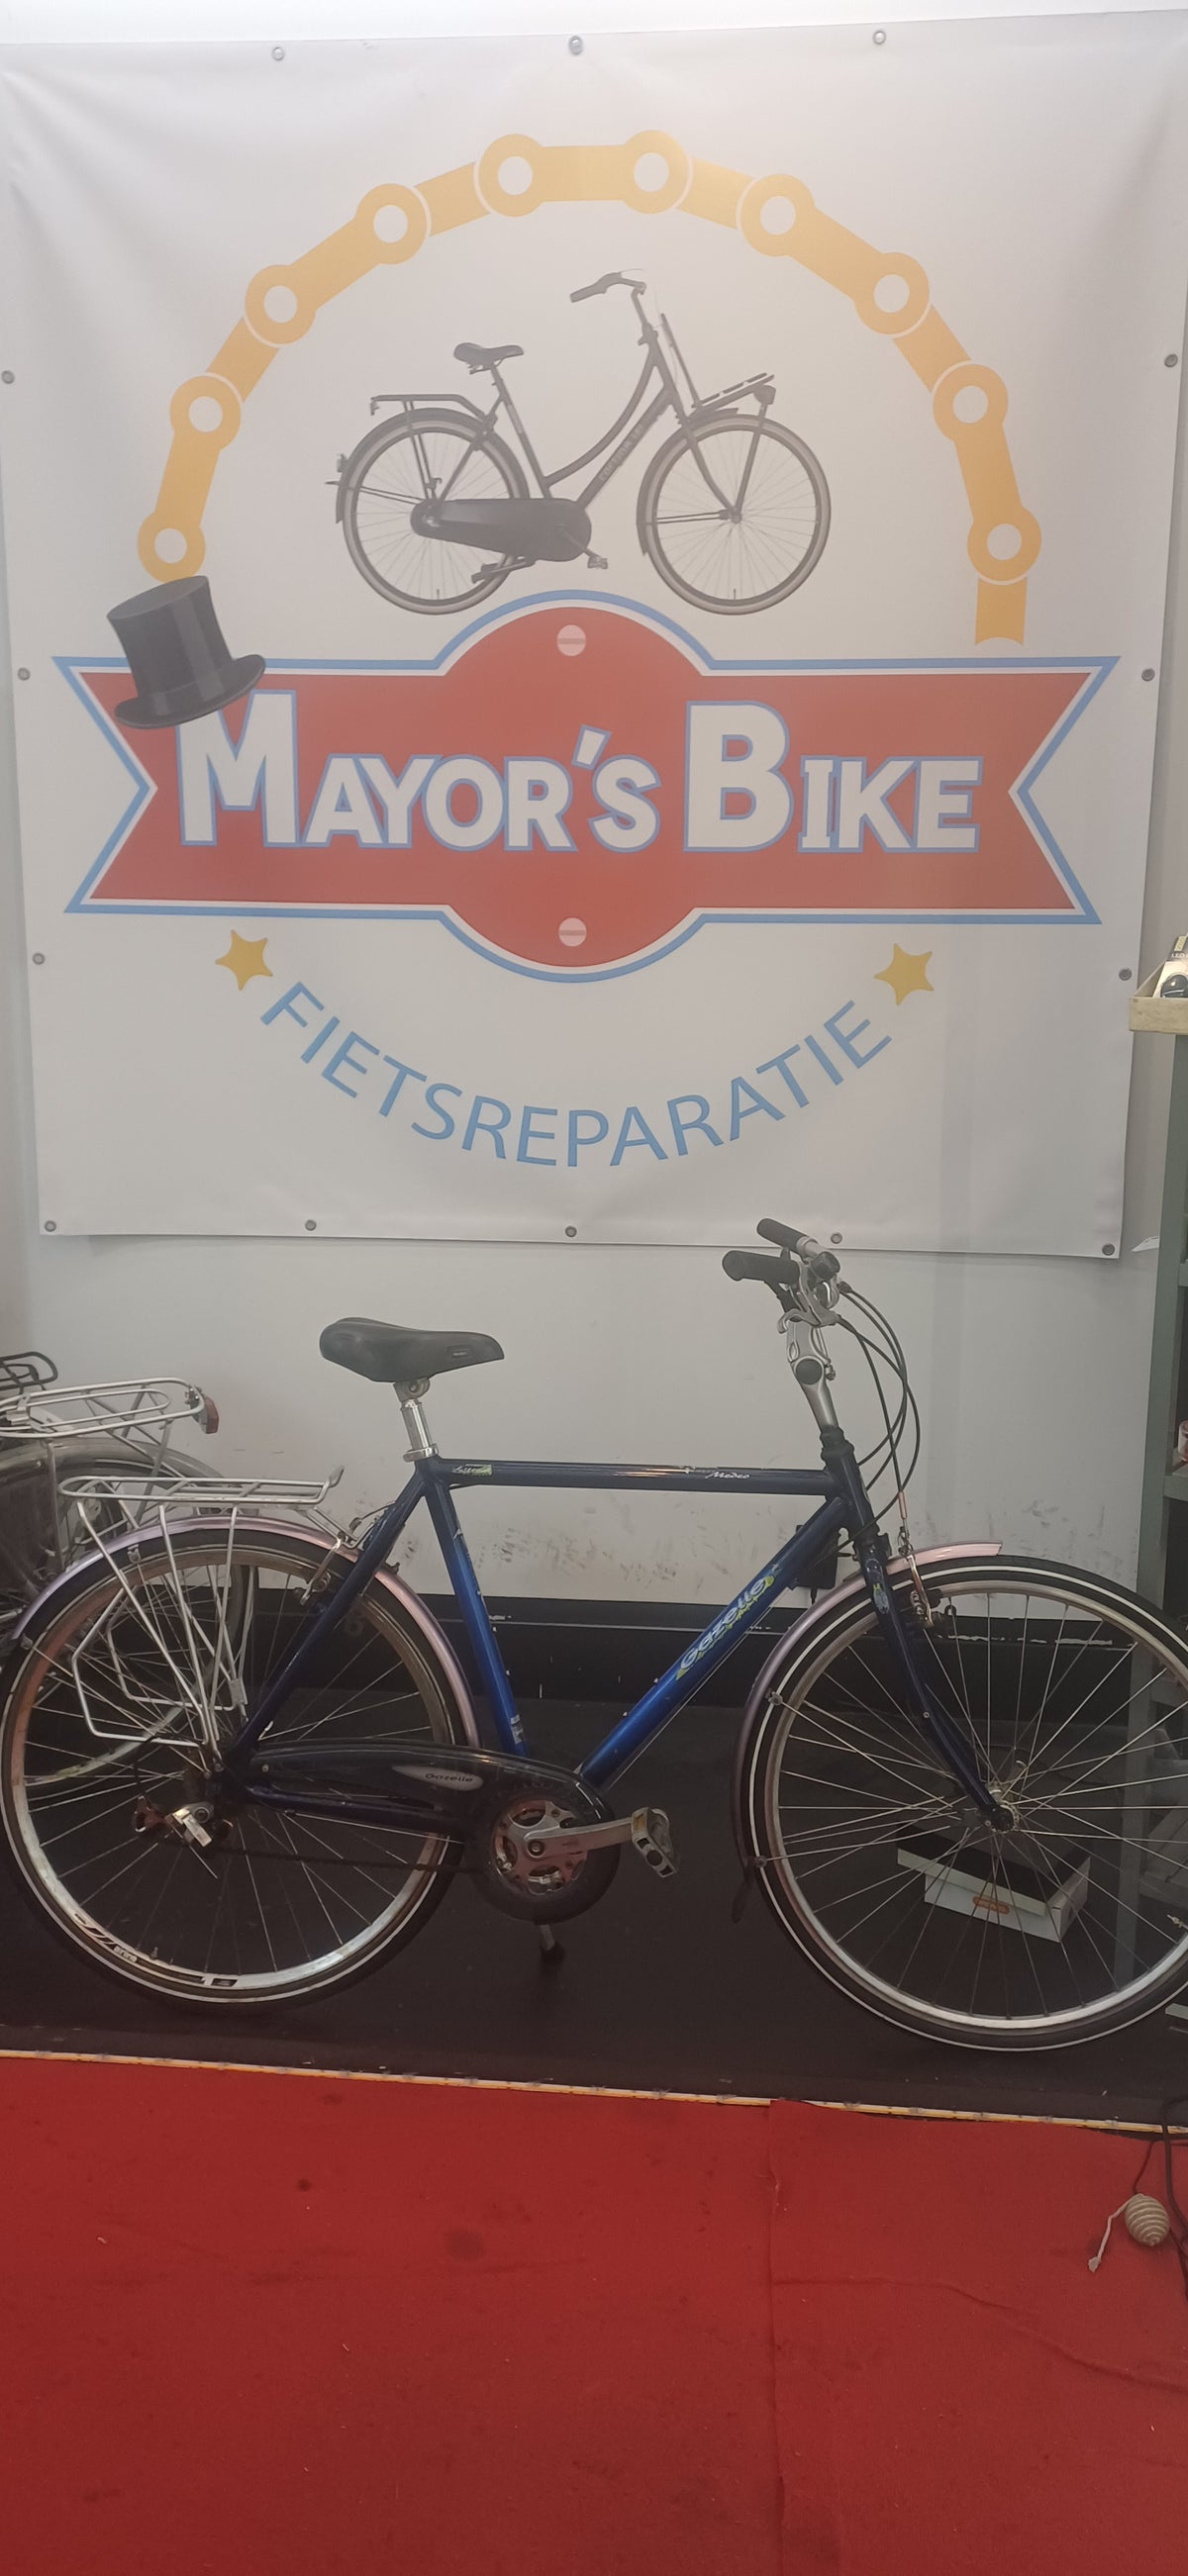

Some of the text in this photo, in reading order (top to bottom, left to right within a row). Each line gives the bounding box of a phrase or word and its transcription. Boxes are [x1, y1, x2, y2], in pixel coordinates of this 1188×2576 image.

[175, 689, 984, 853] MAYOR'S BIKE
[259, 981, 892, 1168] FIETSREPARATIE
[680, 1576, 766, 1670] Gazelle
